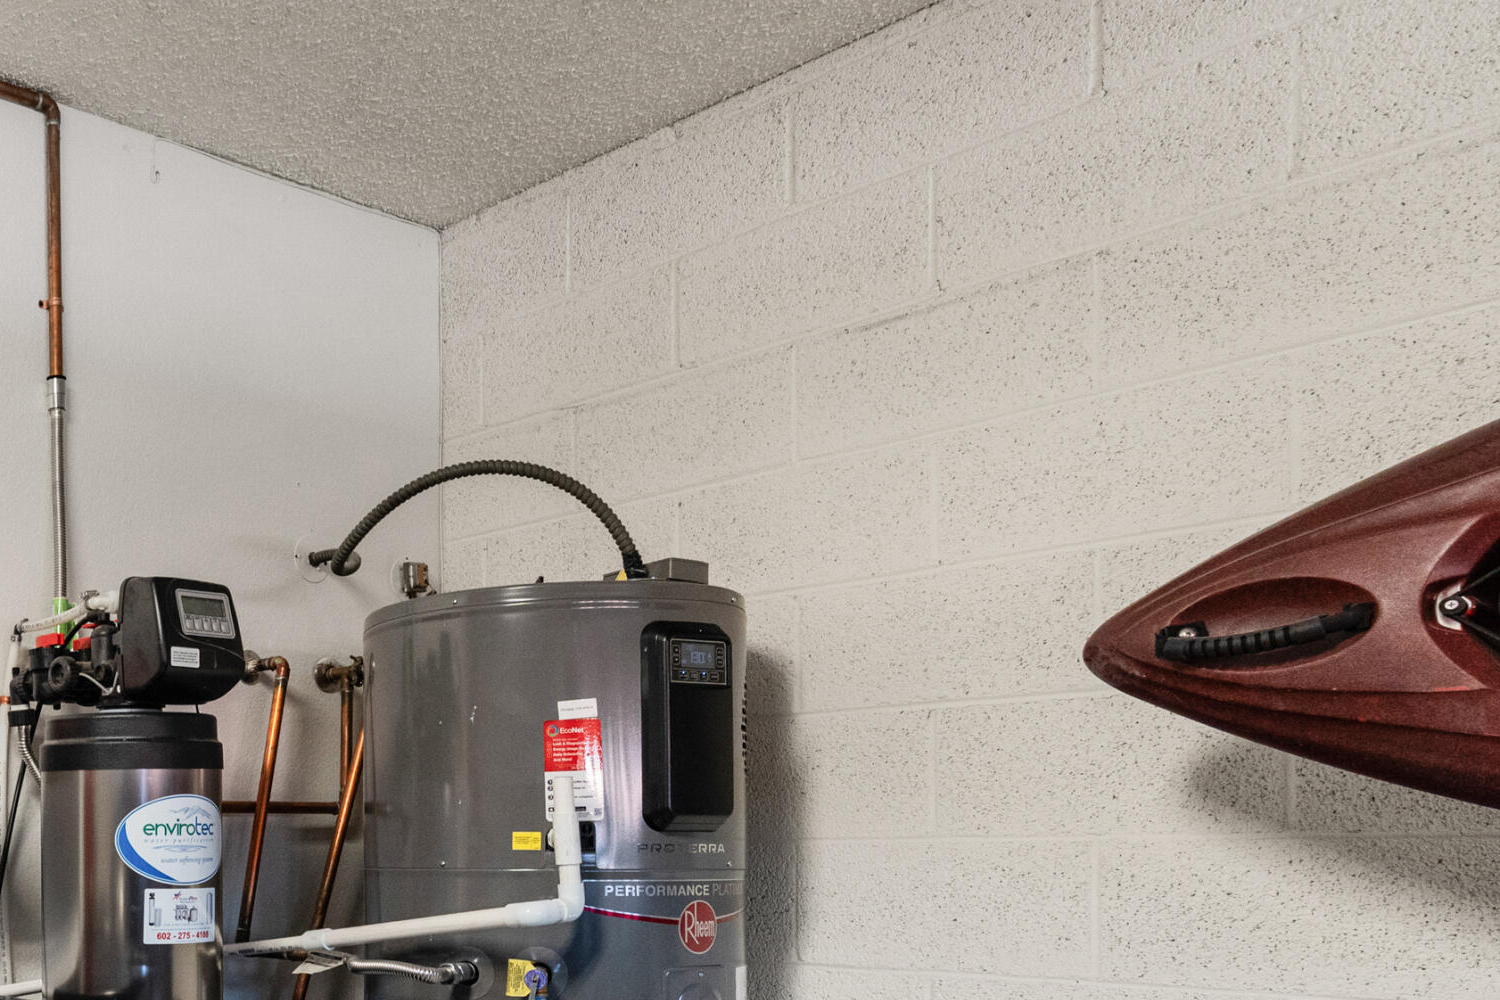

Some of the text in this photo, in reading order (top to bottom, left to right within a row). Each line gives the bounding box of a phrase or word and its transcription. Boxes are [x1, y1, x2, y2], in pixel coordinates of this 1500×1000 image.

[143, 816, 214, 836] envirotec
[637, 843, 725, 854] PROERRA
[604, 884, 710, 896] PERFORMANCE
[684, 901, 715, 945] Rheem
[156, 931, 171, 940] 602
[178, 930, 191, 939] 275
